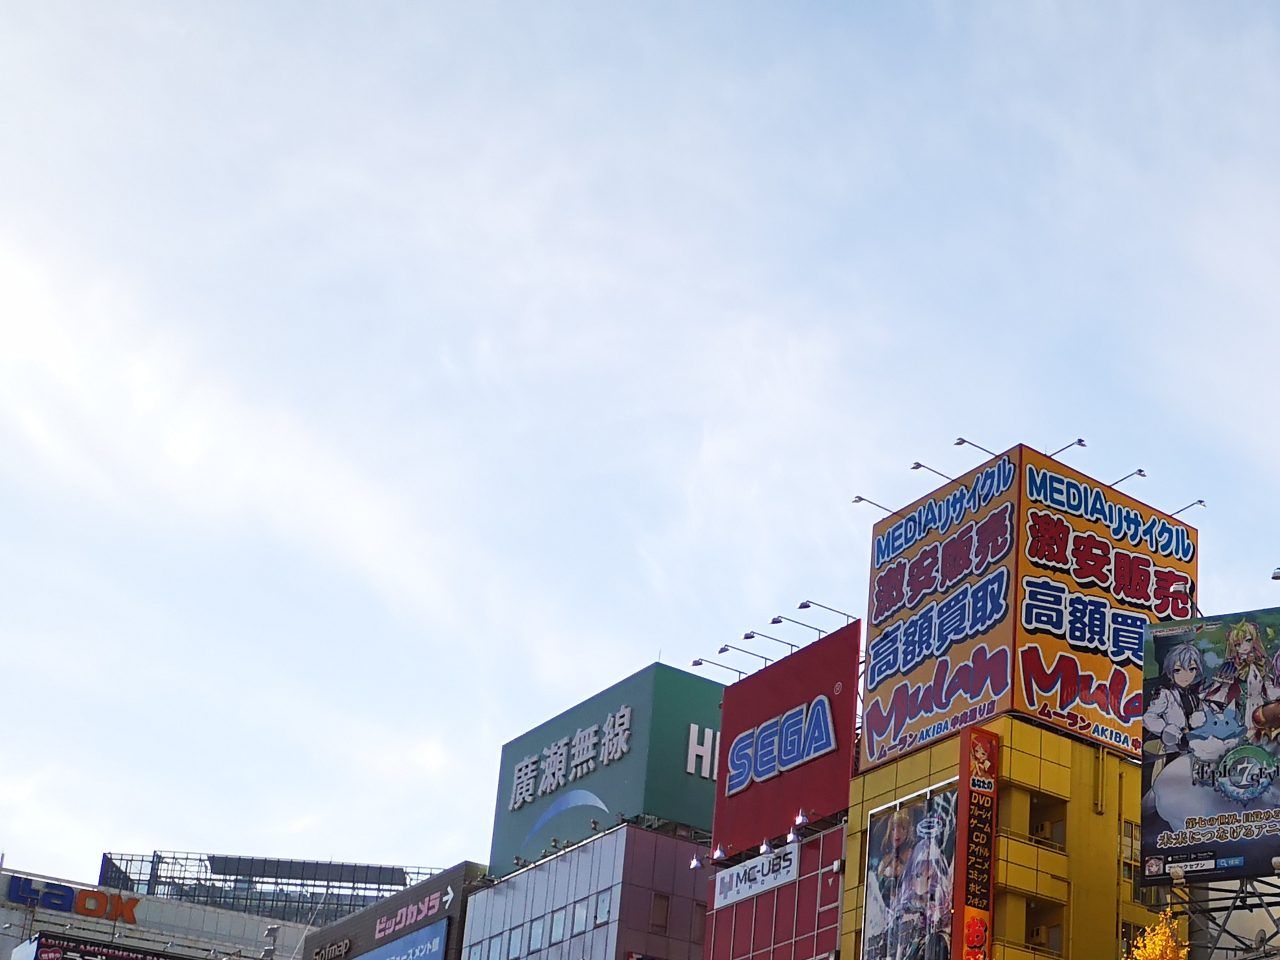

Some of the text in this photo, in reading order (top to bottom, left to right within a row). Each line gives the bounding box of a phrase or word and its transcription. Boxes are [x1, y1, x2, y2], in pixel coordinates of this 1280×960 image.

[874, 456, 1014, 567] MEDIAリサイクル
[1026, 464, 1195, 561] MEDIAリサイクル
[873, 502, 1013, 624] 激安販売
[1025, 509, 1192, 619] 激安販売
[868, 567, 1008, 690] 高額買取
[725, 694, 837, 798] SEGA
[877, 733, 918, 762] ムーラン
[918, 719, 949, 743] AKIBA
[1038, 703, 1092, 732] ムーラン
[1092, 725, 1130, 748] AKIBA
[507, 704, 633, 813] 廣瀬無線
[971, 793, 991, 807] DVD
[970, 820, 991, 833] ゲーム
[972, 833, 987, 845] CD
[735, 851, 793, 886] MC-UBS
[968, 857, 990, 870] アニメ
[375, 890, 443, 940] ビックカメラ
